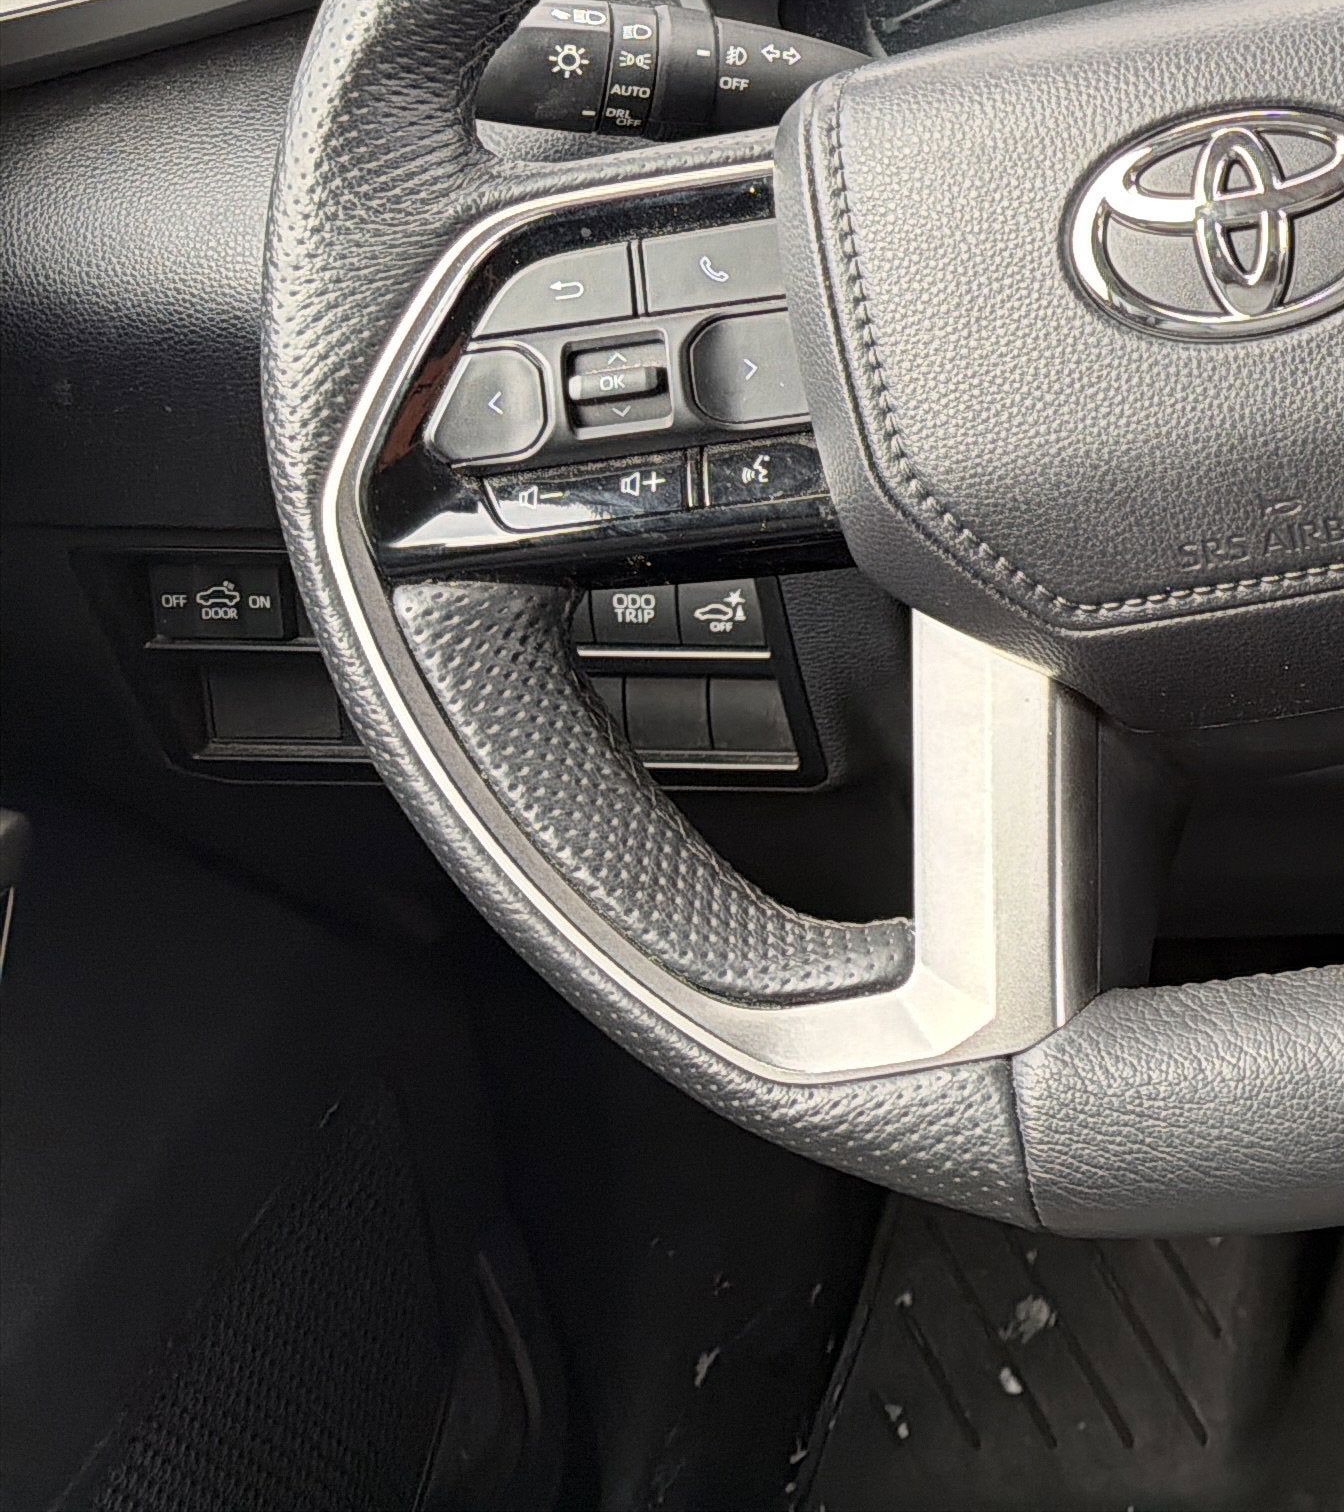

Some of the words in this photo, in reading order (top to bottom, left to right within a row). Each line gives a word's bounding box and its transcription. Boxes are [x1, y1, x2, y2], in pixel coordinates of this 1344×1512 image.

[610, 83, 651, 98] AUTO
[719, 76, 750, 92] OFF
[605, 107, 631, 119] DRL
[615, 117, 642, 127] OFF
[600, 373, 626, 391] OK
[161, 595, 188, 609] OFF
[248, 595, 271, 609] ON
[612, 593, 656, 609] ODO
[201, 607, 239, 620] DOOR
[614, 608, 655, 623] TRIP
[709, 621, 734, 633] OFF
